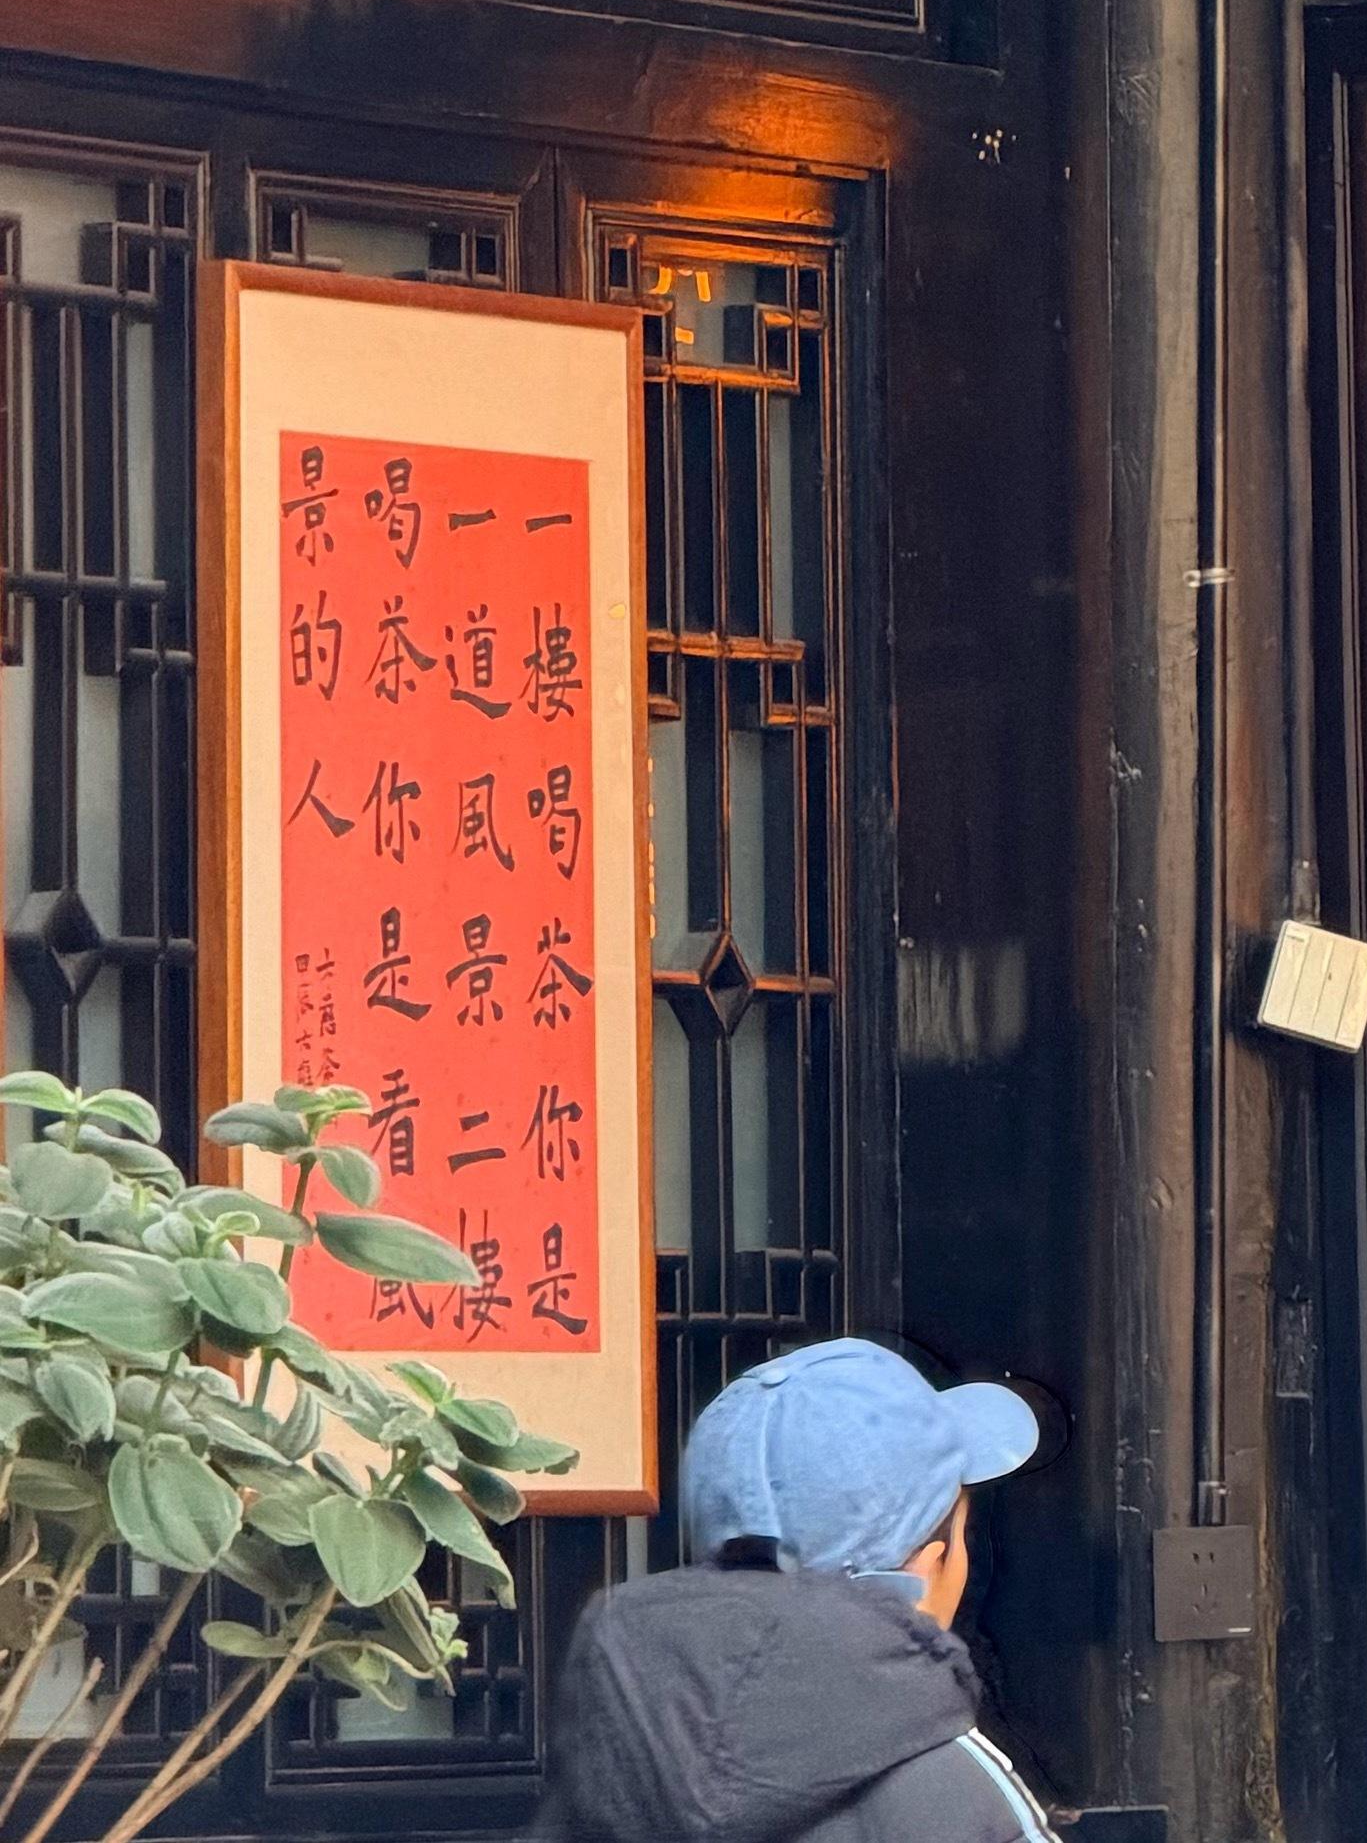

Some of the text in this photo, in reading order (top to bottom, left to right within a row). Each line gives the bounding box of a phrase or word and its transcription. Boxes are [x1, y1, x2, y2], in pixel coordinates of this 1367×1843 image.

[281, 445, 356, 840] 景的人
[521, 511, 594, 1336] 一樓喝茶你是
